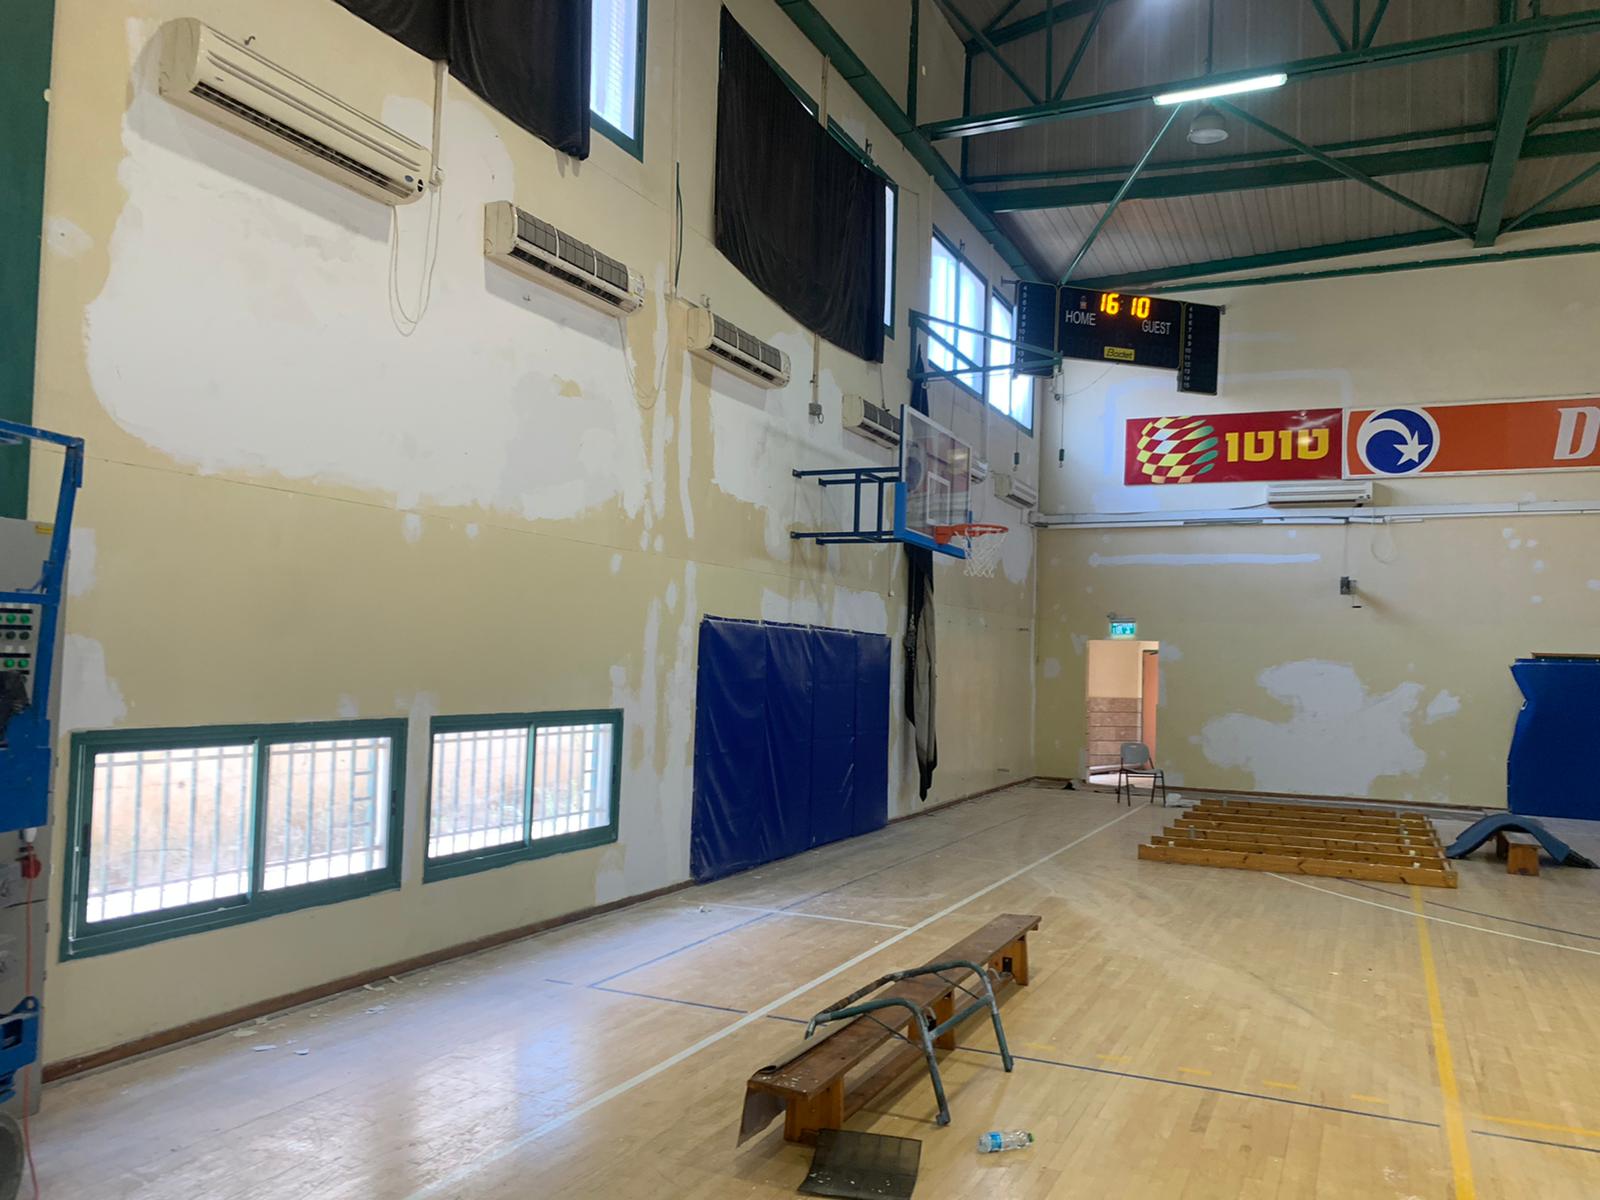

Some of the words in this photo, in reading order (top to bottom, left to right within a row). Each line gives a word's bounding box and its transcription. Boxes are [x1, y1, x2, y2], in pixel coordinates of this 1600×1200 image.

[1100, 292, 1120, 315] 16
[1130, 297, 1151, 319] 10
[1065, 310, 1097, 326] HOME
[1142, 320, 1172, 335] GUEST
[1553, 406, 1600, 460] D
[1225, 428, 1329, 462] טוטו
